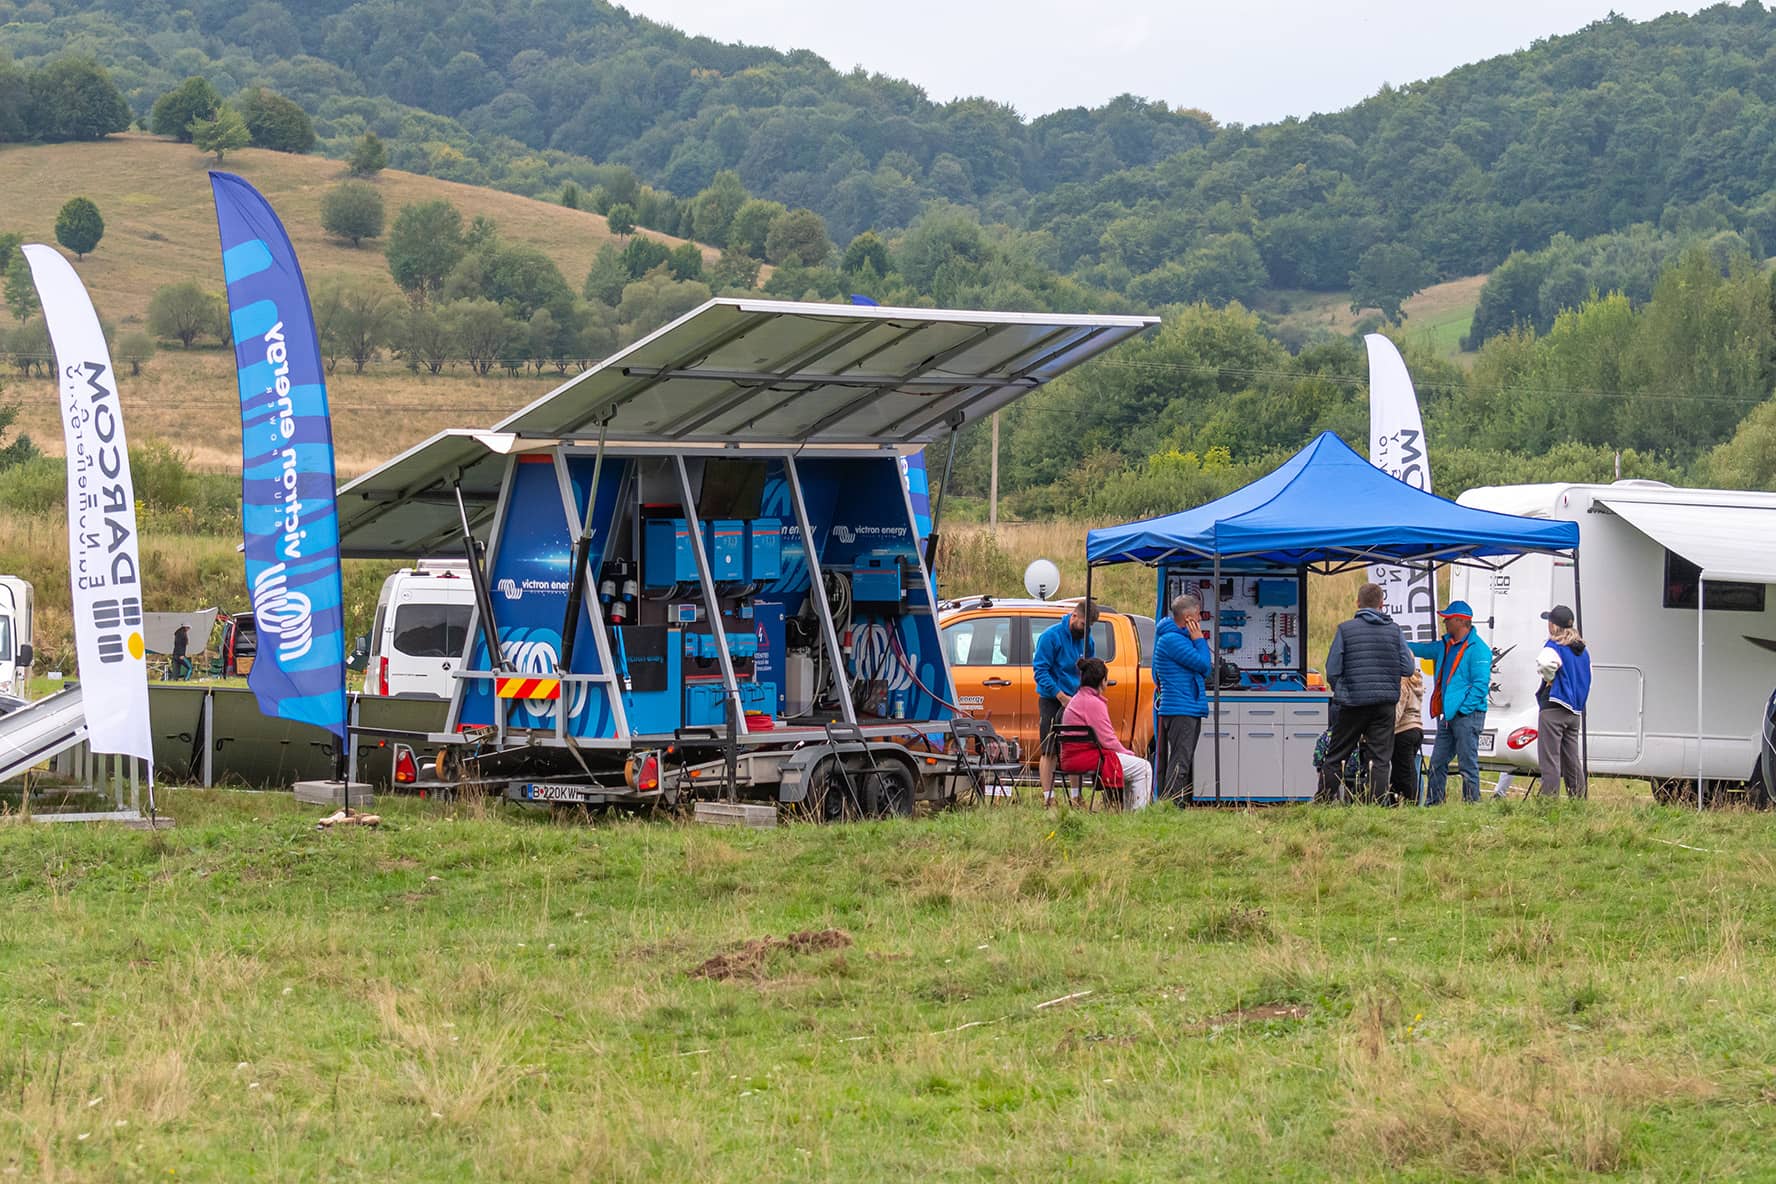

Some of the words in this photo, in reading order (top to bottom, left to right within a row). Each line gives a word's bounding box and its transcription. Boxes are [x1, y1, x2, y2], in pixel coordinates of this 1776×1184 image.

[854, 524, 880, 535] victron
[881, 527, 908, 537] energy
[522, 578, 550, 589] victron
